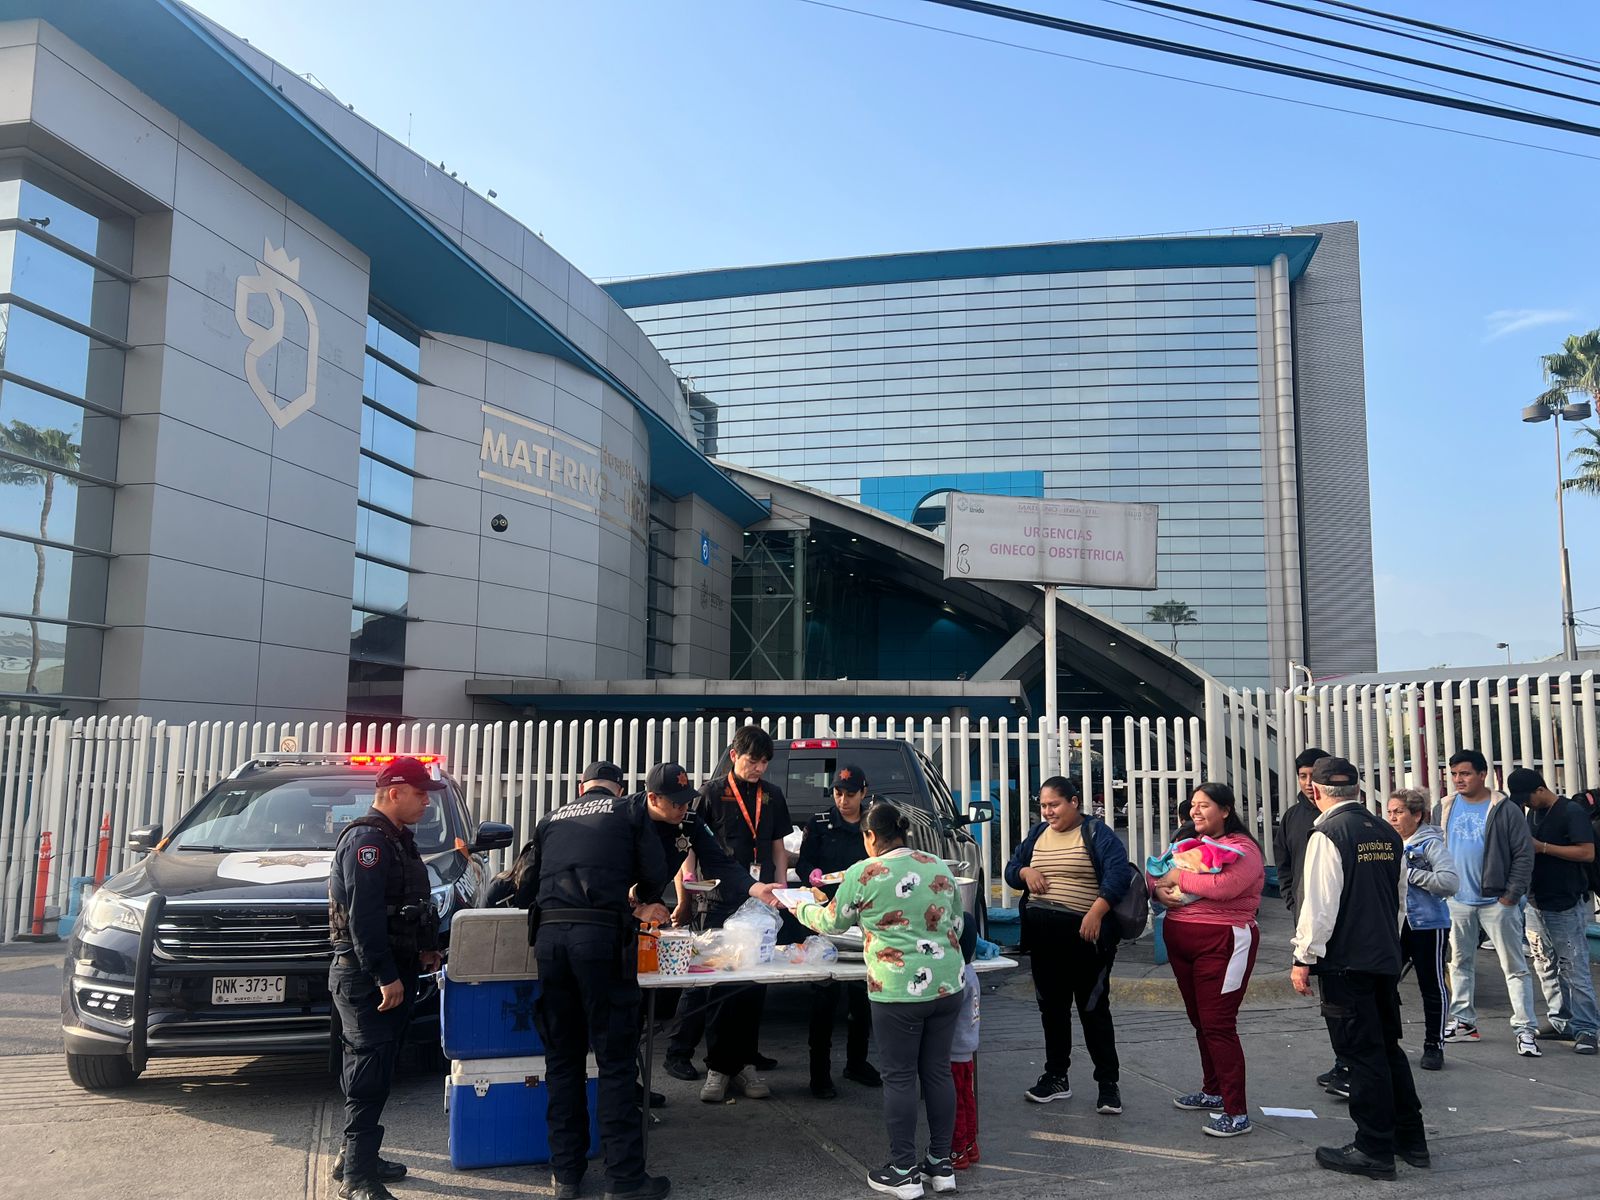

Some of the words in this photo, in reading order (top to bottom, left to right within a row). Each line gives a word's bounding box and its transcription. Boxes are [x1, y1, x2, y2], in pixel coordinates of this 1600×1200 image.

[480, 427, 608, 501] MATERNO
[1023, 526, 1093, 541] URGENCIAS
[990, 543, 1036, 556] GINECO
[1048, 546, 1124, 561] OBSTETRICIA
[550, 805, 614, 822] MUNICIPAL
[557, 799, 613, 813] POLICIA
[1357, 840, 1384, 852] DIVISIÓN
[1385, 842, 1393, 851] DE
[1358, 852, 1394, 863] PROXIMIDAD
[215, 977, 284, 994] RNK-373-C
